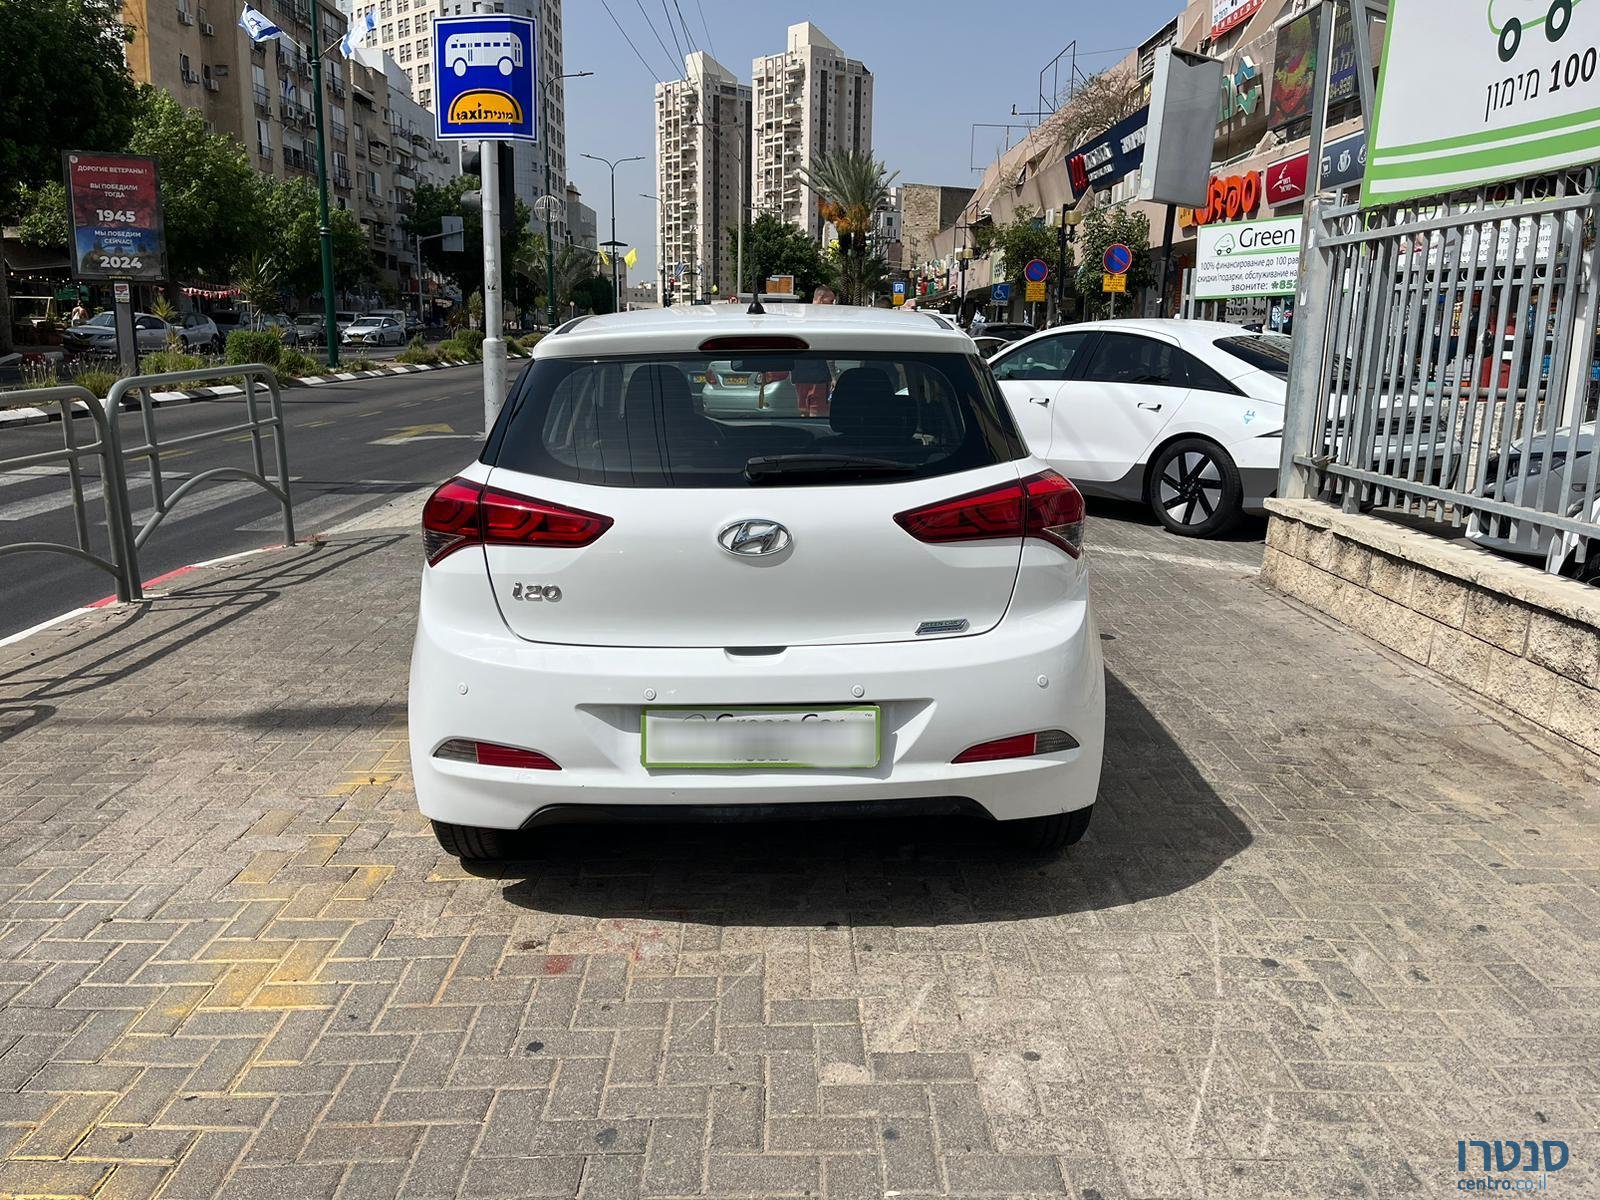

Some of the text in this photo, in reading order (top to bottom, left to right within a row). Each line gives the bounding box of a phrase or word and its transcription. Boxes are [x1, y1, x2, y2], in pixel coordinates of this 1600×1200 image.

[1485, 69, 1540, 122] מימון
[456, 102, 482, 120] taxi
[483, 109, 514, 120] מונית
[77, 165, 108, 173] ДОРОГИЕ
[109, 166, 144, 174] ВЕТЕРАНЫ
[101, 183, 138, 191] ПОБЕДИЛИ
[96, 209, 136, 223] 1945
[107, 230, 142, 238] ПОБЕДИМ
[1239, 227, 1295, 248] Green
[99, 255, 143, 269] 2024
[1200, 262, 1215, 271] 100%
[1215, 258, 1265, 272] финансирование
[1265, 258, 1274, 267] до
[1275, 256, 1287, 266] 100
[1244, 269, 1289, 281] обслуживание
[1231, 282, 1268, 292] звоните:
[512, 581, 562, 602] i20
